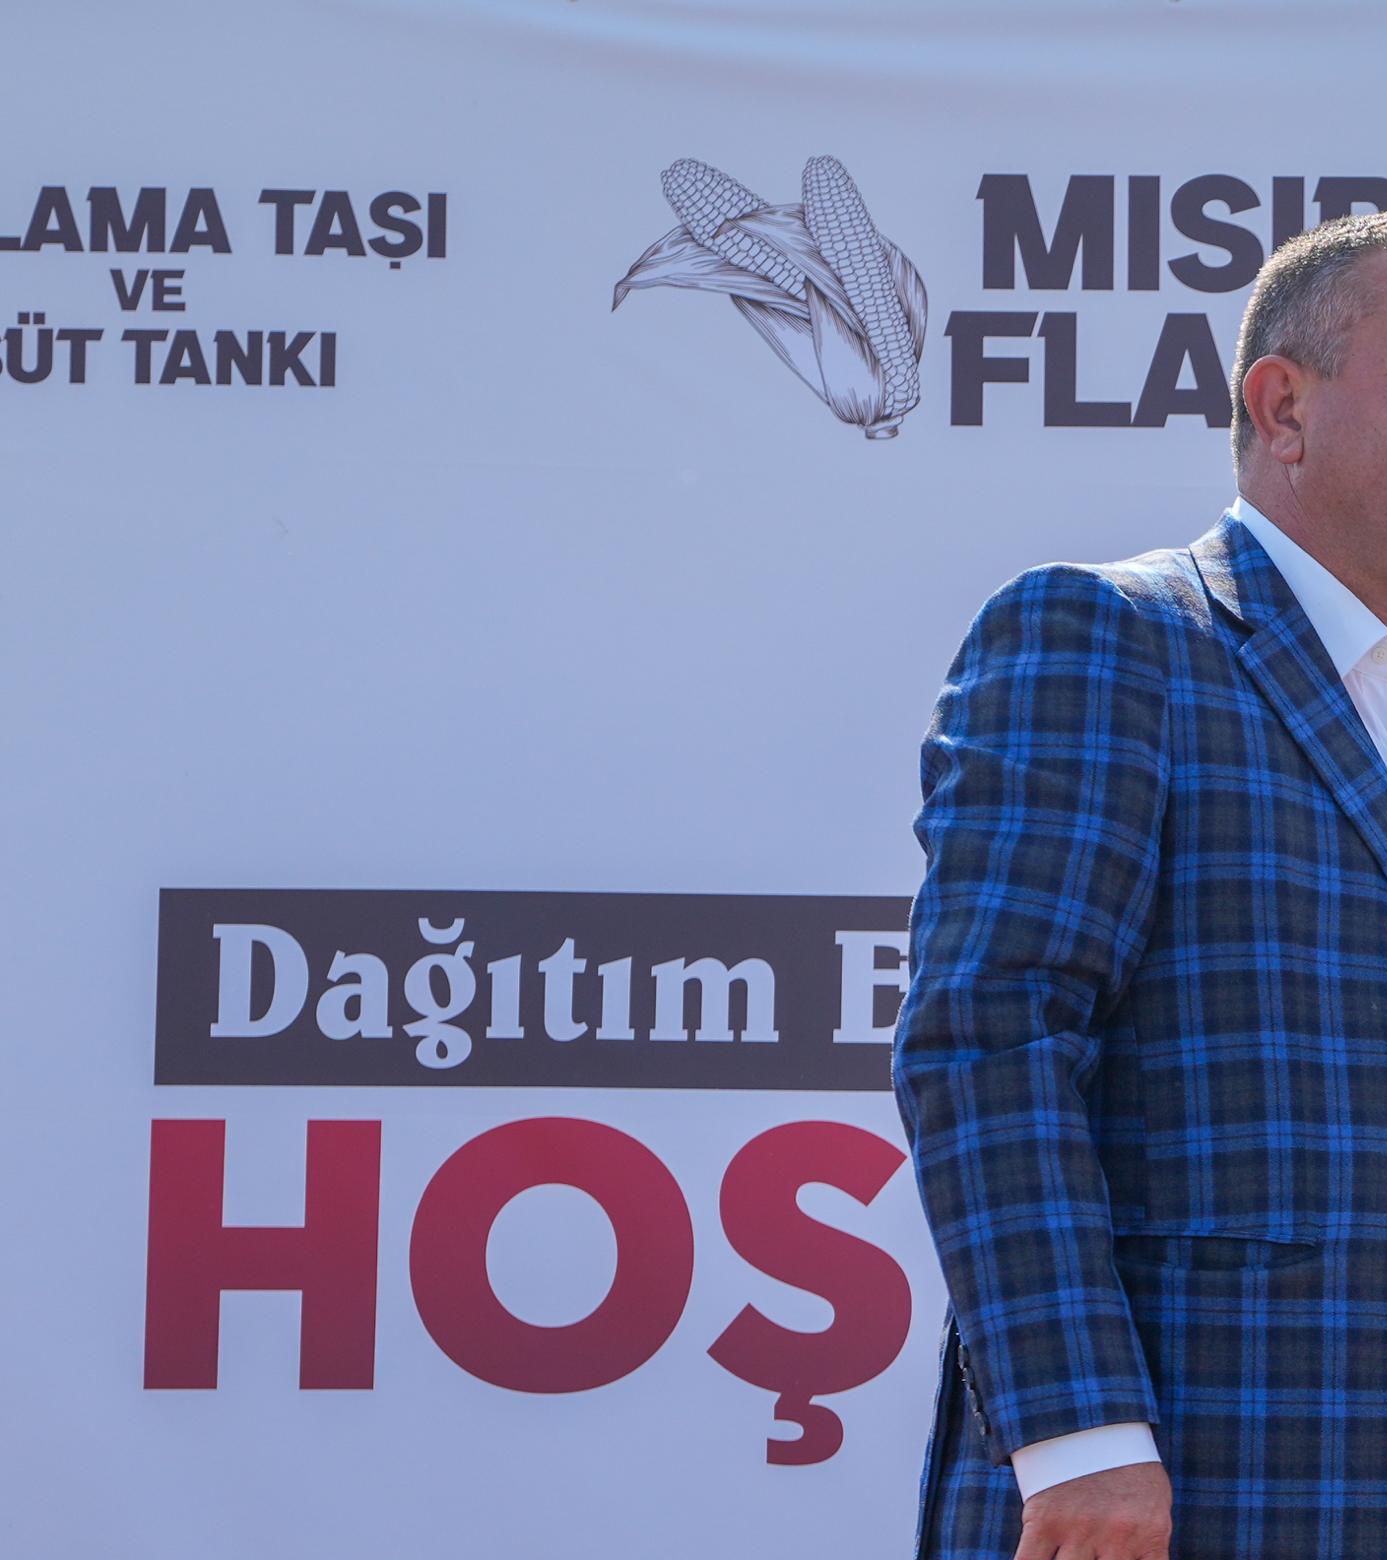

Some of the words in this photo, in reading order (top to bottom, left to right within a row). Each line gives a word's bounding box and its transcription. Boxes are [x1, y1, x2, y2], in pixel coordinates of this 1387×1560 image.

[258, 189, 447, 269] TAŞI
[110, 269, 187, 311] VE
[0, 312, 104, 386] ÜT
[120, 329, 337, 388] TANKI
[944, 311, 1231, 428] FLA
[210, 917, 780, 1070] Dağıtım
[143, 1116, 912, 1467] HOŞ
